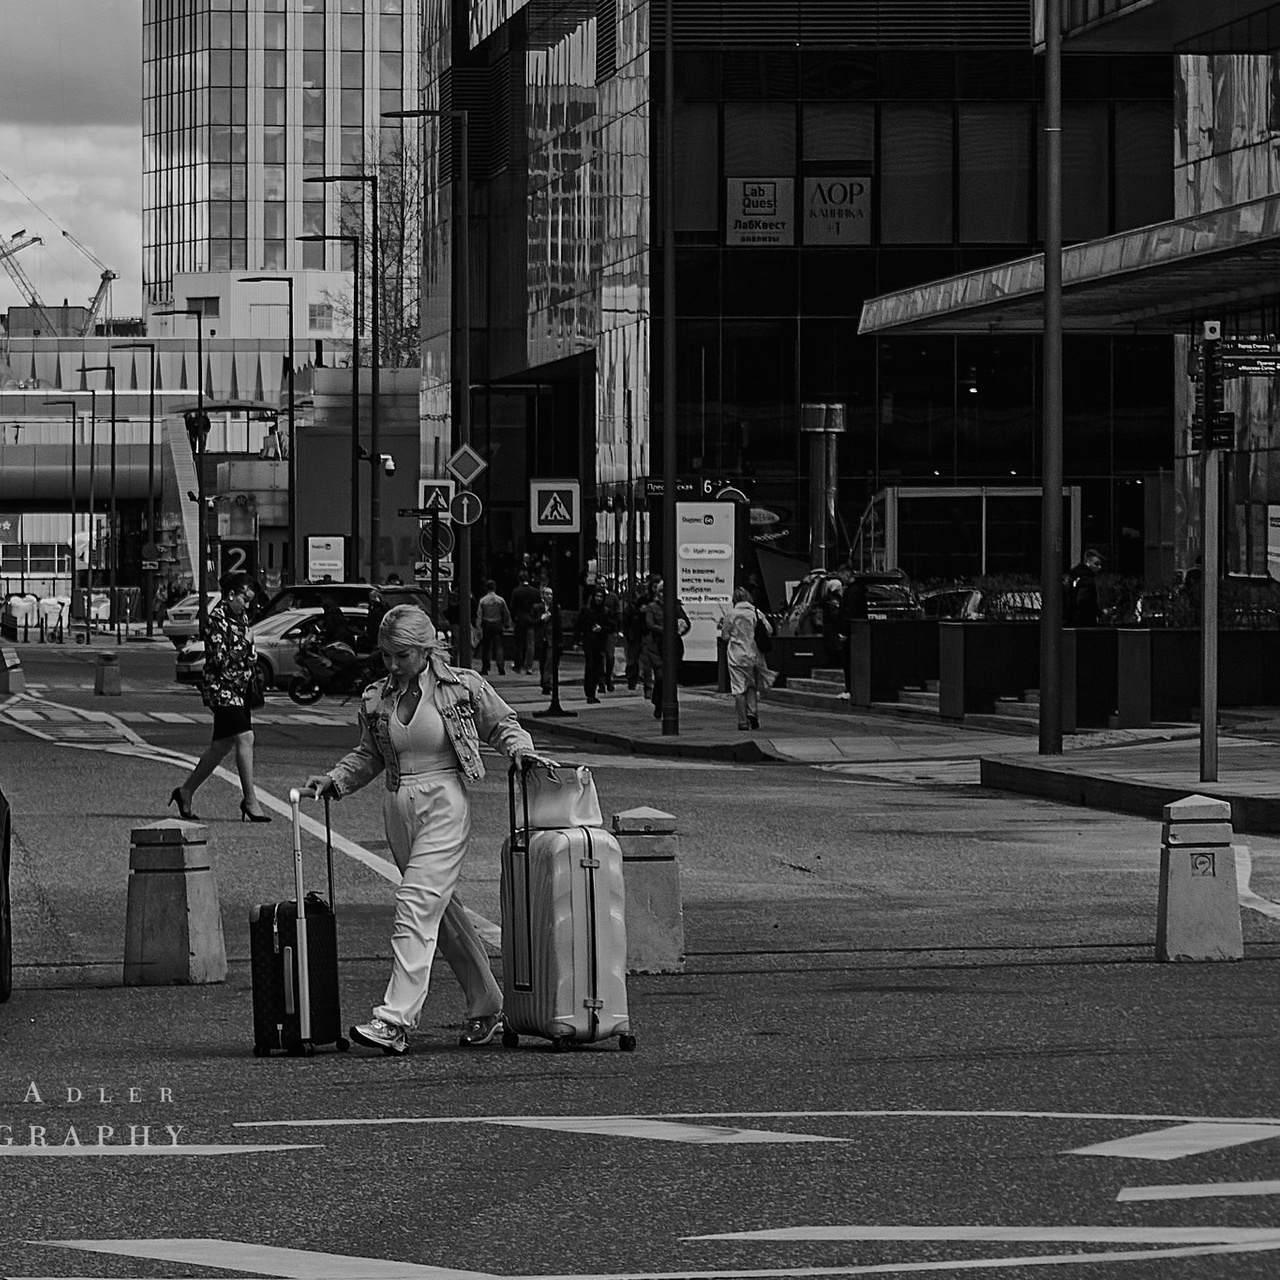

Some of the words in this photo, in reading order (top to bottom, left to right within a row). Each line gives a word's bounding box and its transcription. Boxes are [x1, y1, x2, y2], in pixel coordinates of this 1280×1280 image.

[743, 185, 765, 197] Lab
[811, 182, 864, 205] ЛОР
[743, 197, 777, 209] Quest
[733, 220, 787, 230] ЛабКвест
[740, 235, 780, 243] анализы
[704, 479, 712, 494] 6
[227, 547, 247, 575] 2
